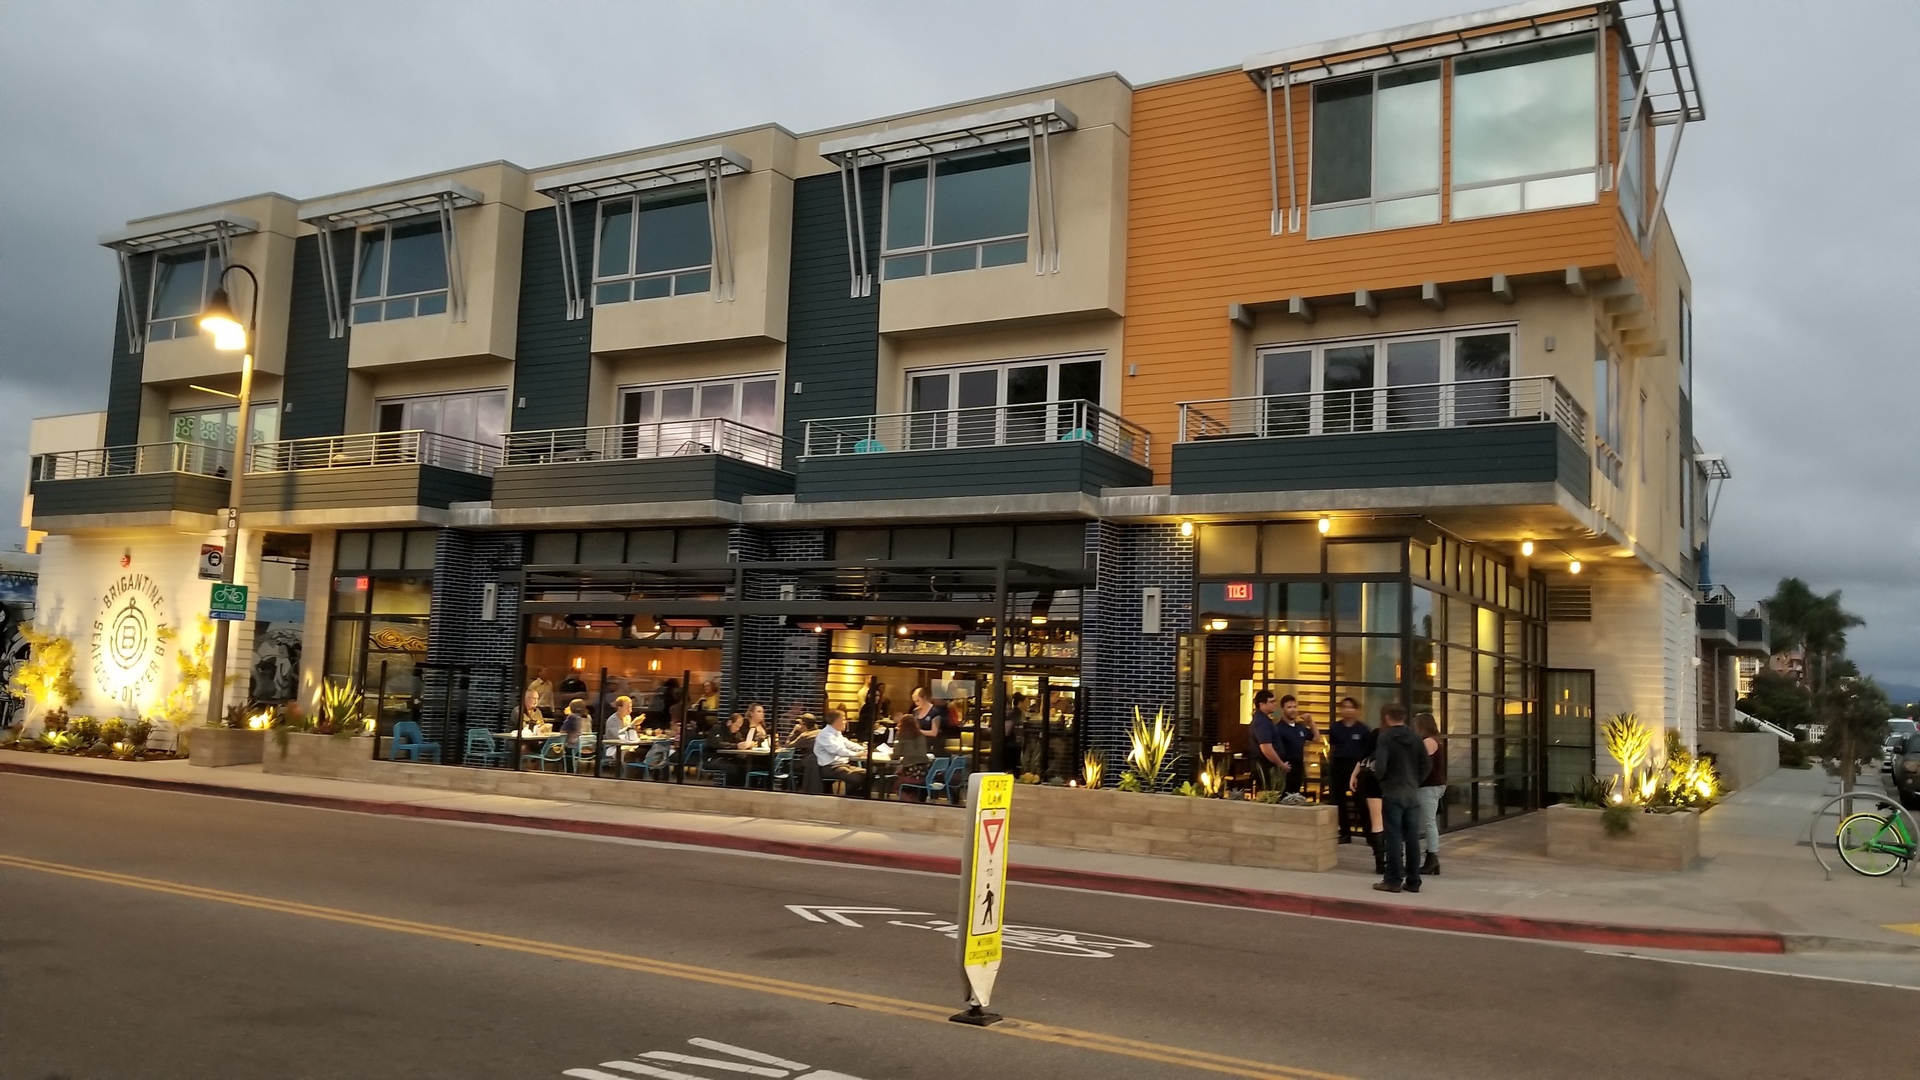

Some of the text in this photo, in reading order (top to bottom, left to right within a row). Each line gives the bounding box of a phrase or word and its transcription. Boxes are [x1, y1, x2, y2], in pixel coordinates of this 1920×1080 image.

[103, 573, 164, 610] BRIGANTINE
[155, 622, 168, 657] BAR
[987, 780, 1008, 791] STATE
[988, 794, 1002, 805] LAW
